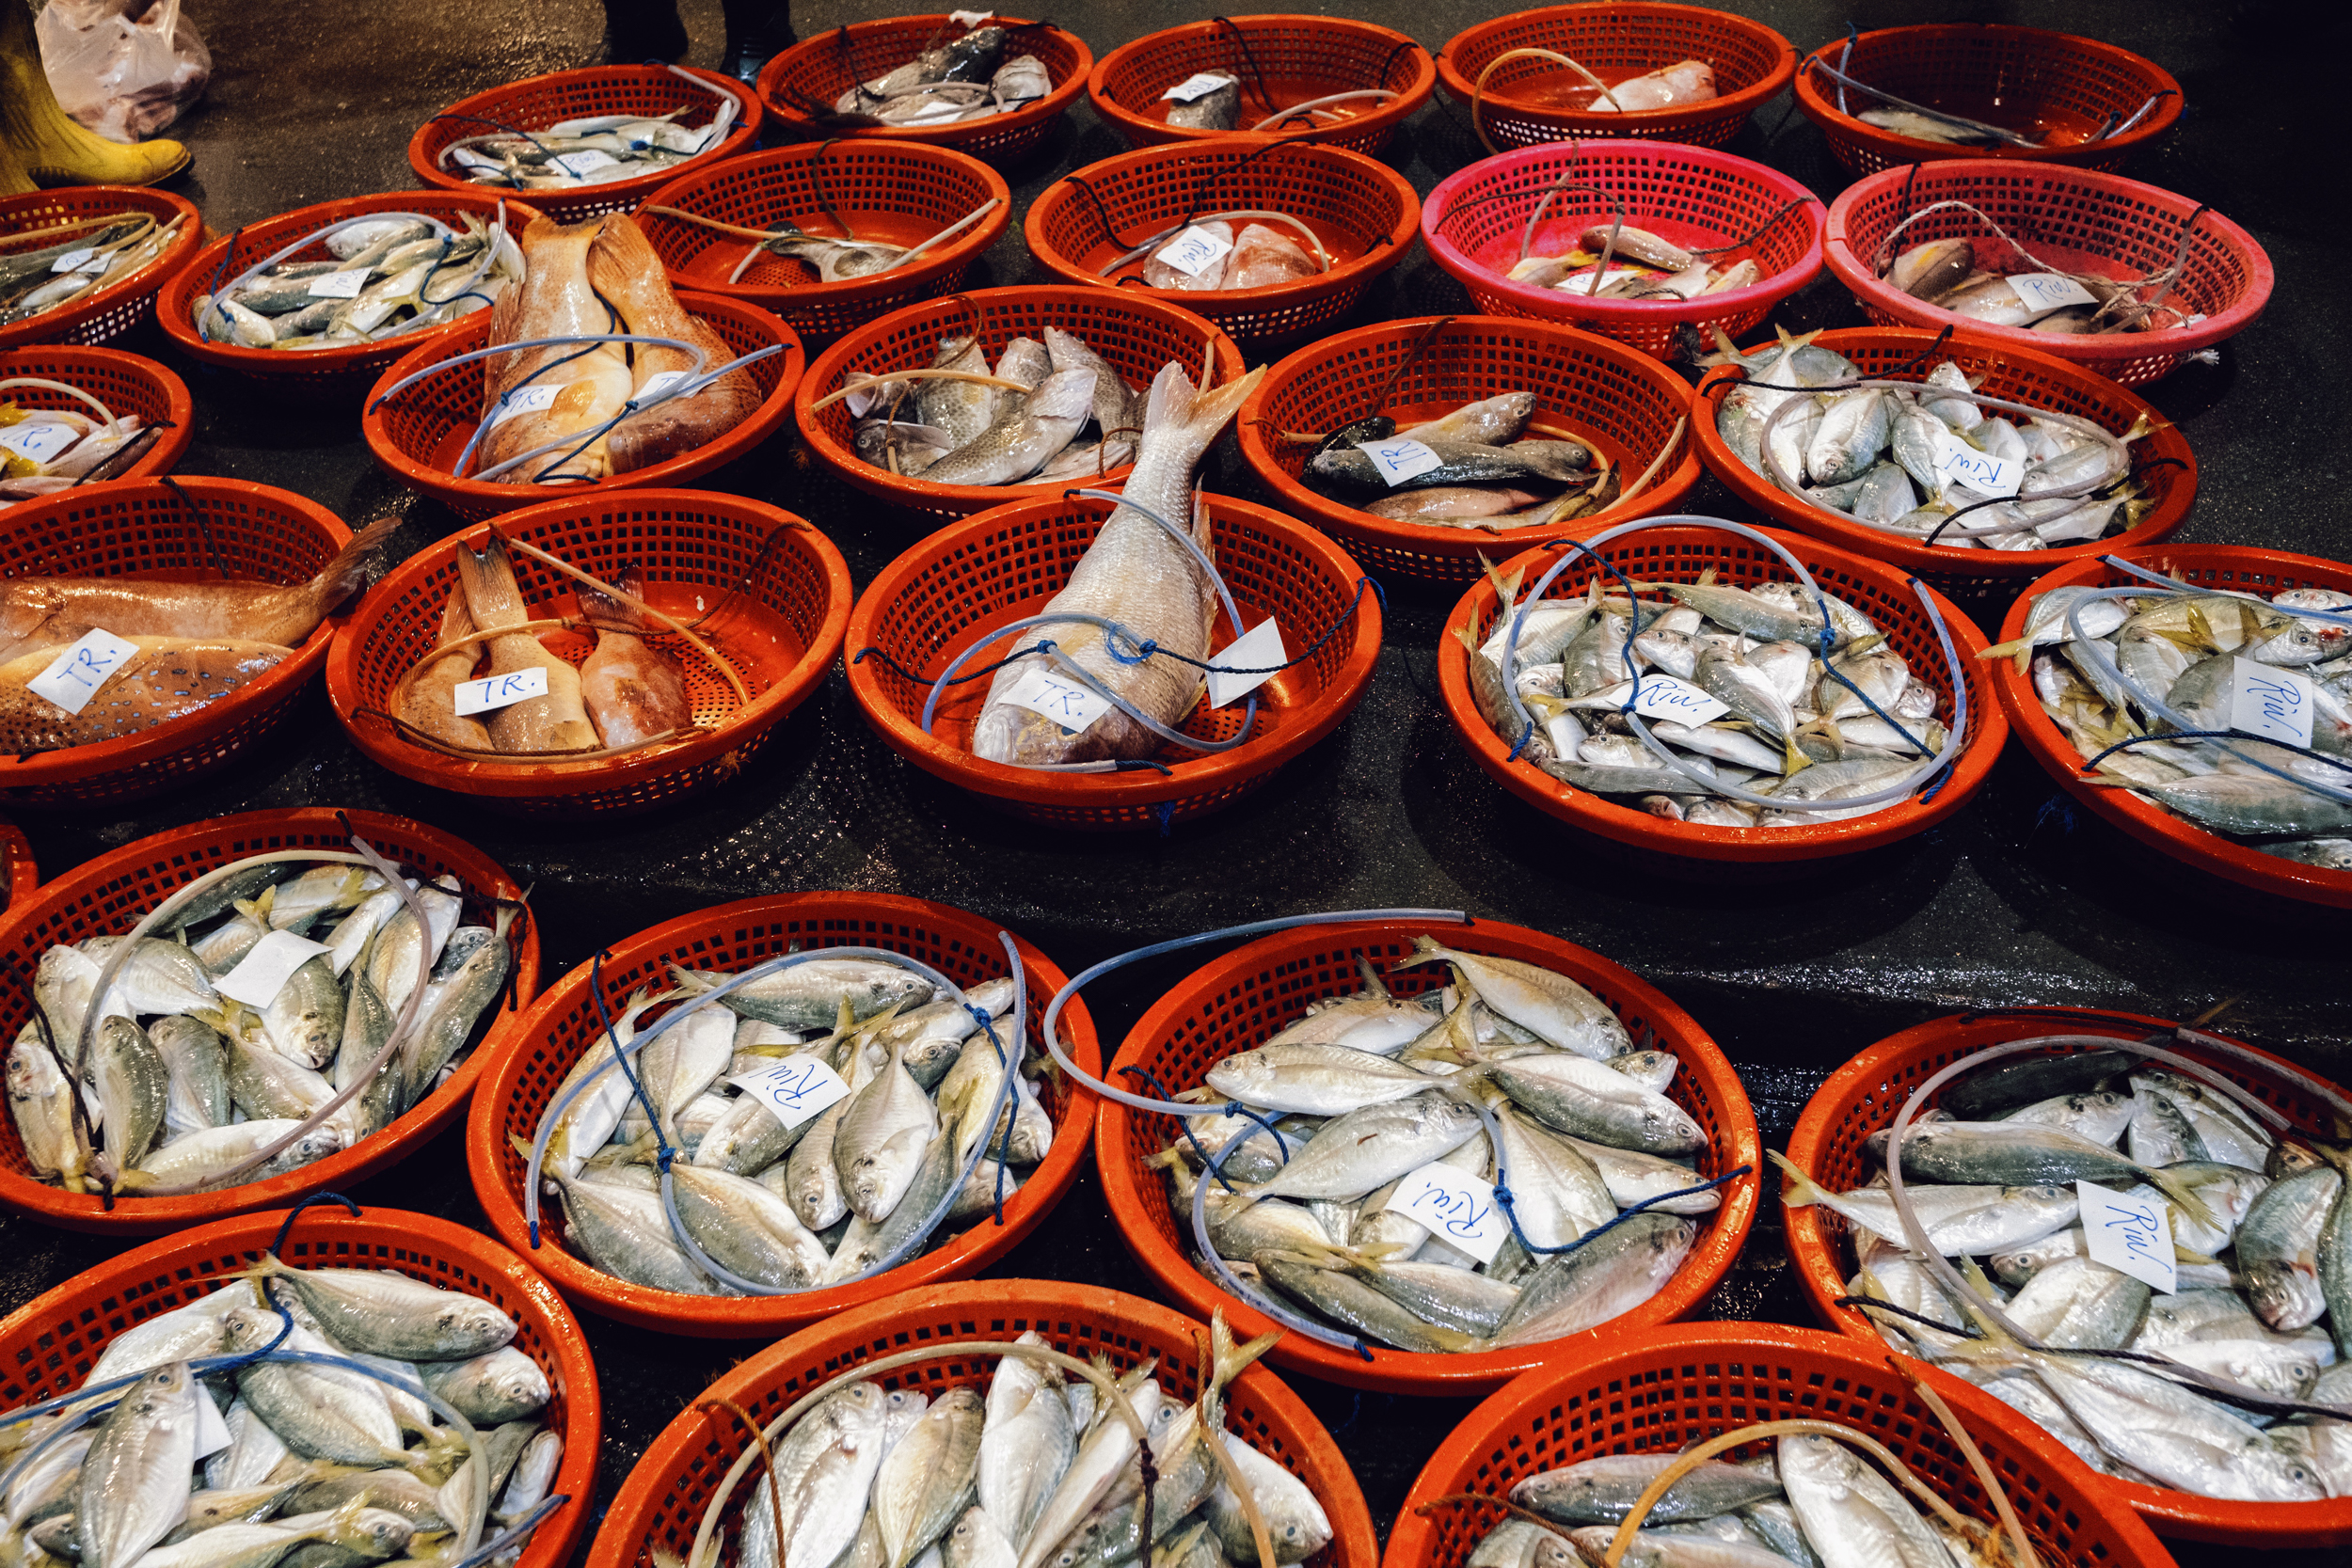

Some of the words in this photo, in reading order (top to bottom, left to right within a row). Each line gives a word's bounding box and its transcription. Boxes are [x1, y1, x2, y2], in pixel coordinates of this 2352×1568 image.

[509, 388, 545, 412] TR.
[1944, 447, 2007, 488] Riw.
[56, 647, 117, 687] TR.
[477, 674, 535, 704] TR.
[1034, 679, 1086, 717] TR.
[1638, 679, 1712, 713] Riw.
[2247, 676, 2303, 738] Riw.
[747, 1062, 829, 1111] Riw.
[1412, 1181, 1489, 1239] Riw.
[2105, 1204, 2172, 1274] Riw.
